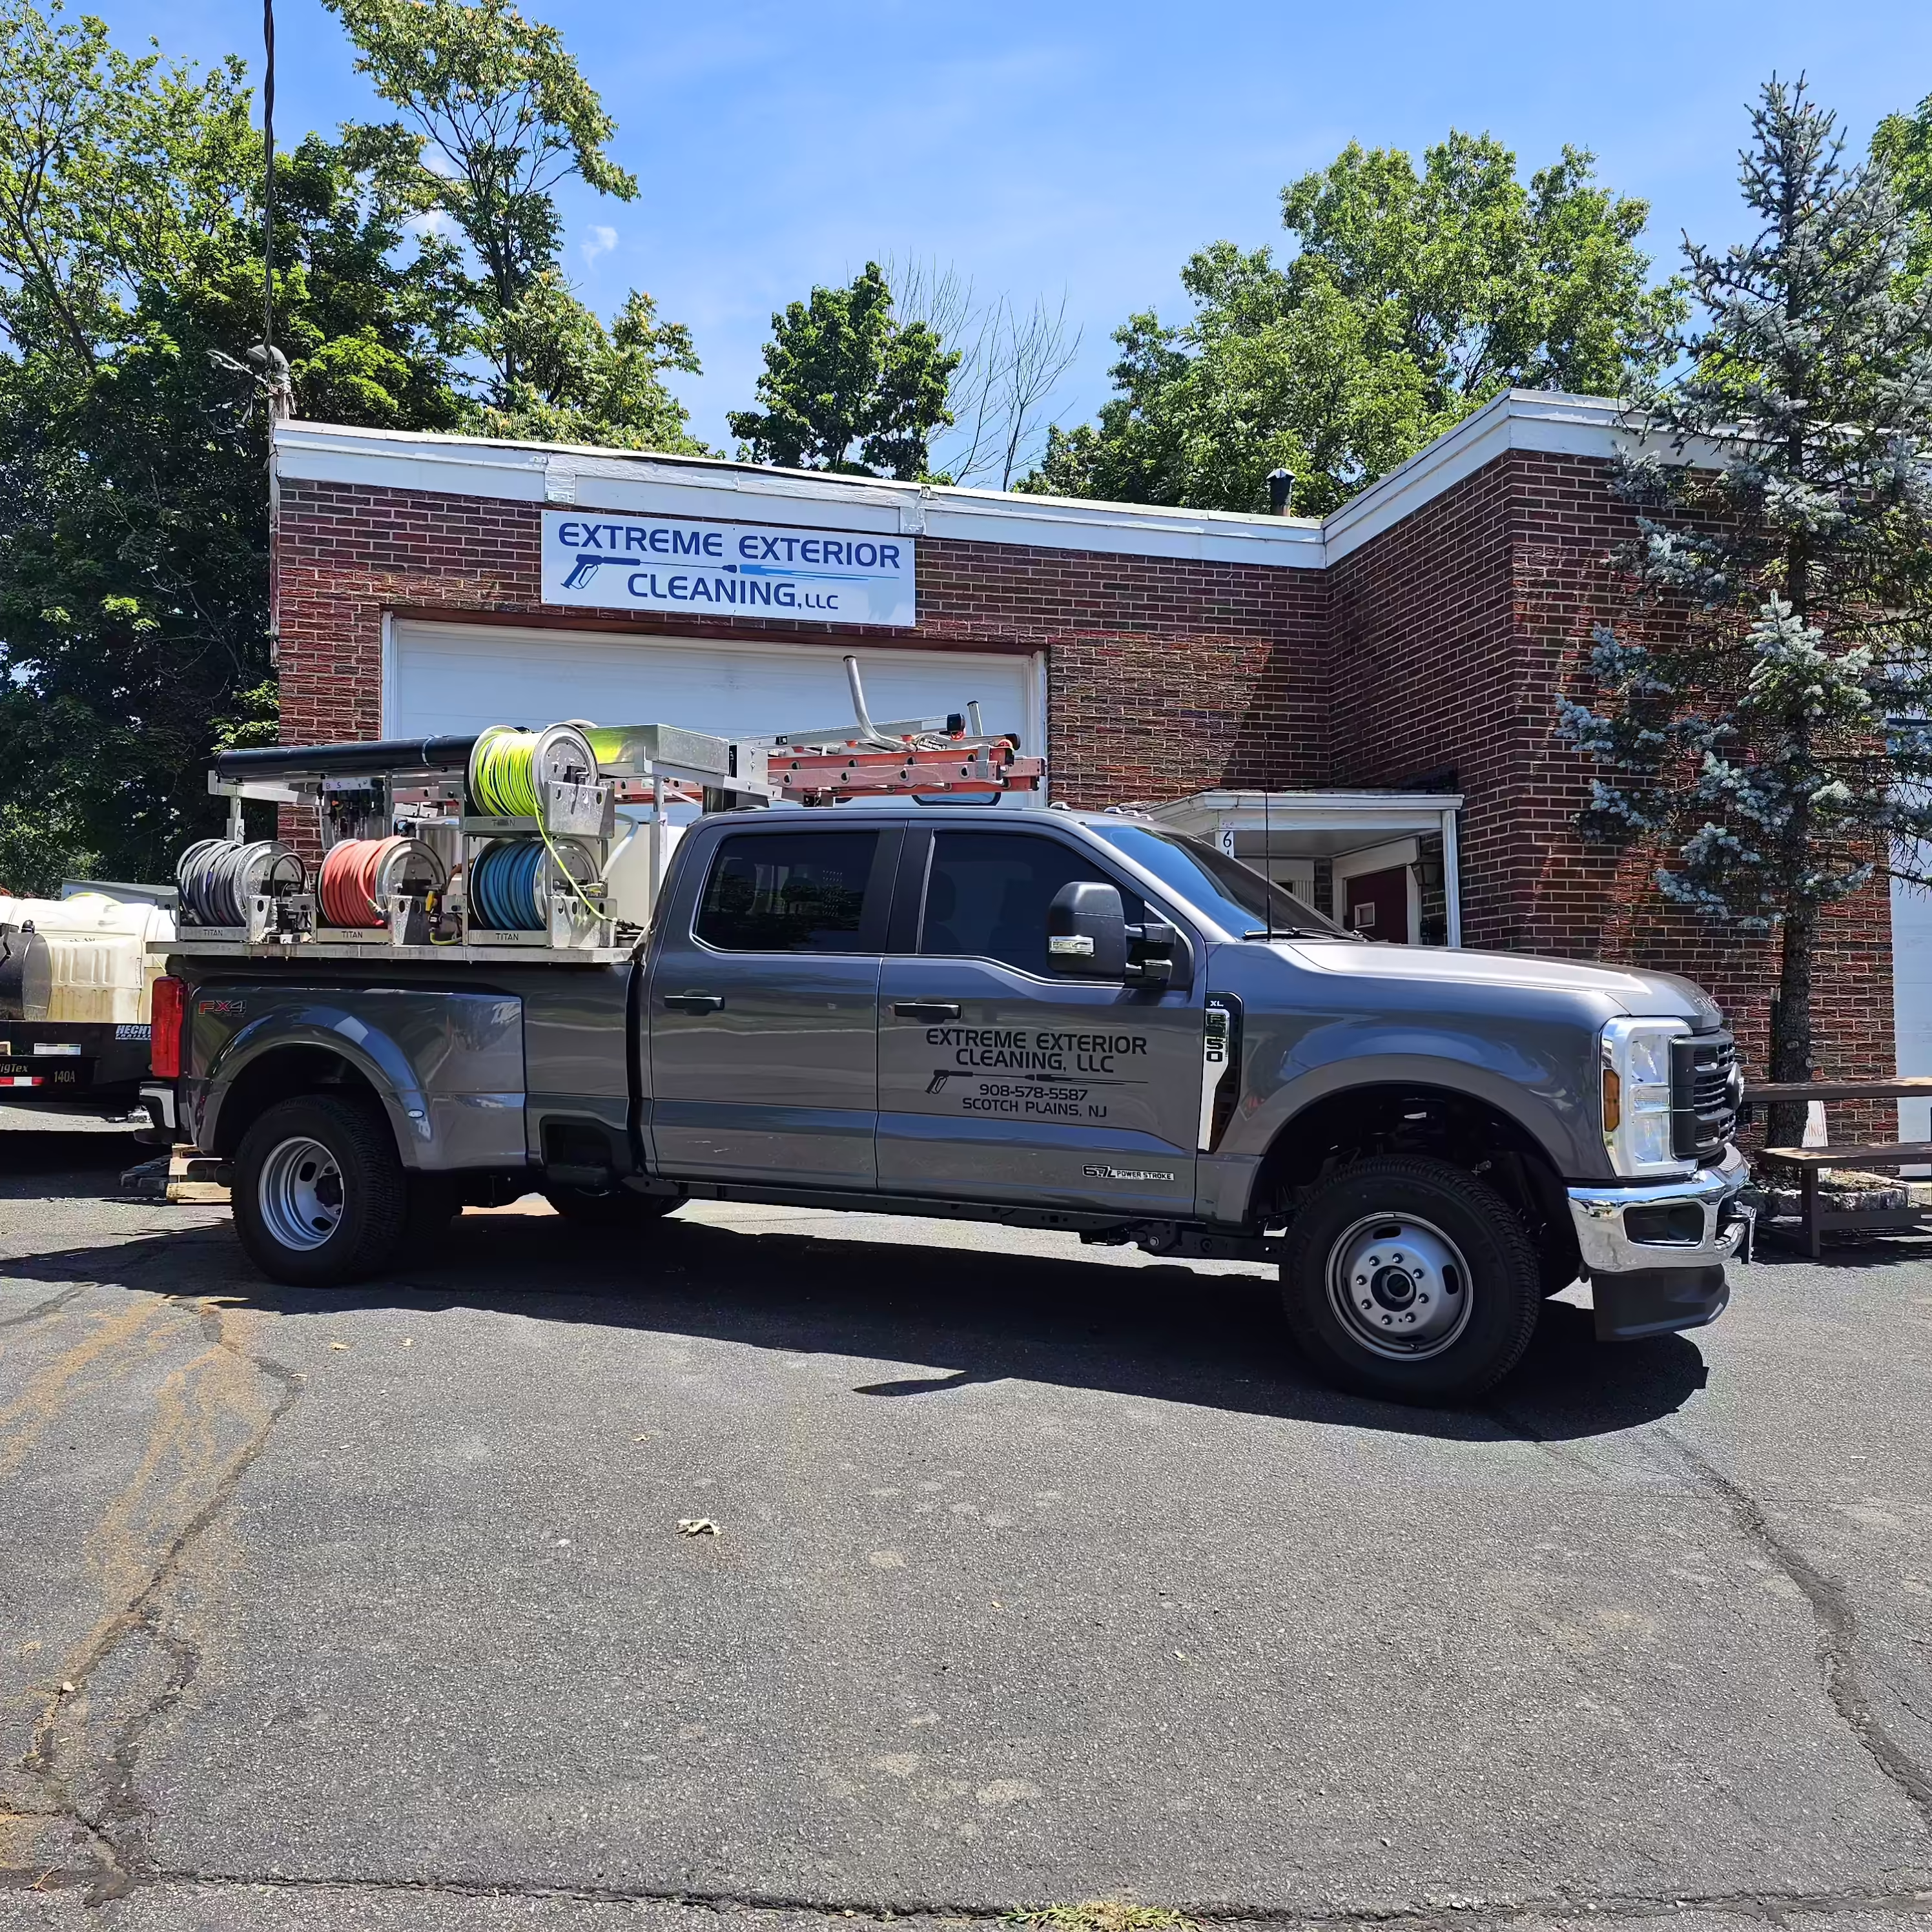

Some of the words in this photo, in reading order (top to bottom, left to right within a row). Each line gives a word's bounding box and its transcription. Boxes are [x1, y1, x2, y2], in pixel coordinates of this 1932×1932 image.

[559, 522, 723, 557] EXTREME
[739, 535, 900, 569] EXTERIOR
[198, 1000, 247, 1016] FX4
[926, 1028, 1027, 1049] EXTREME
[1036, 1033, 1147, 1055] EXTERIOR
[1206, 1012, 1226, 1063] F50
[0, 1064, 28, 1073] igTex
[956, 1048, 1067, 1072] CLEANING,
[1076, 1054, 1114, 1073] LLC
[54, 1071, 76, 1083] 140A
[980, 1084, 1088, 1101] 908-578-5587
[963, 1098, 1018, 1112] SCOTCH
[1088, 1105, 1107, 1118] NJ
[1805, 1124, 1823, 1136] ING
[1083, 1165, 1116, 1178] 6.7L
[1116, 1169, 1142, 1178] POWER
[1142, 1172, 1172, 1180] STROKE
